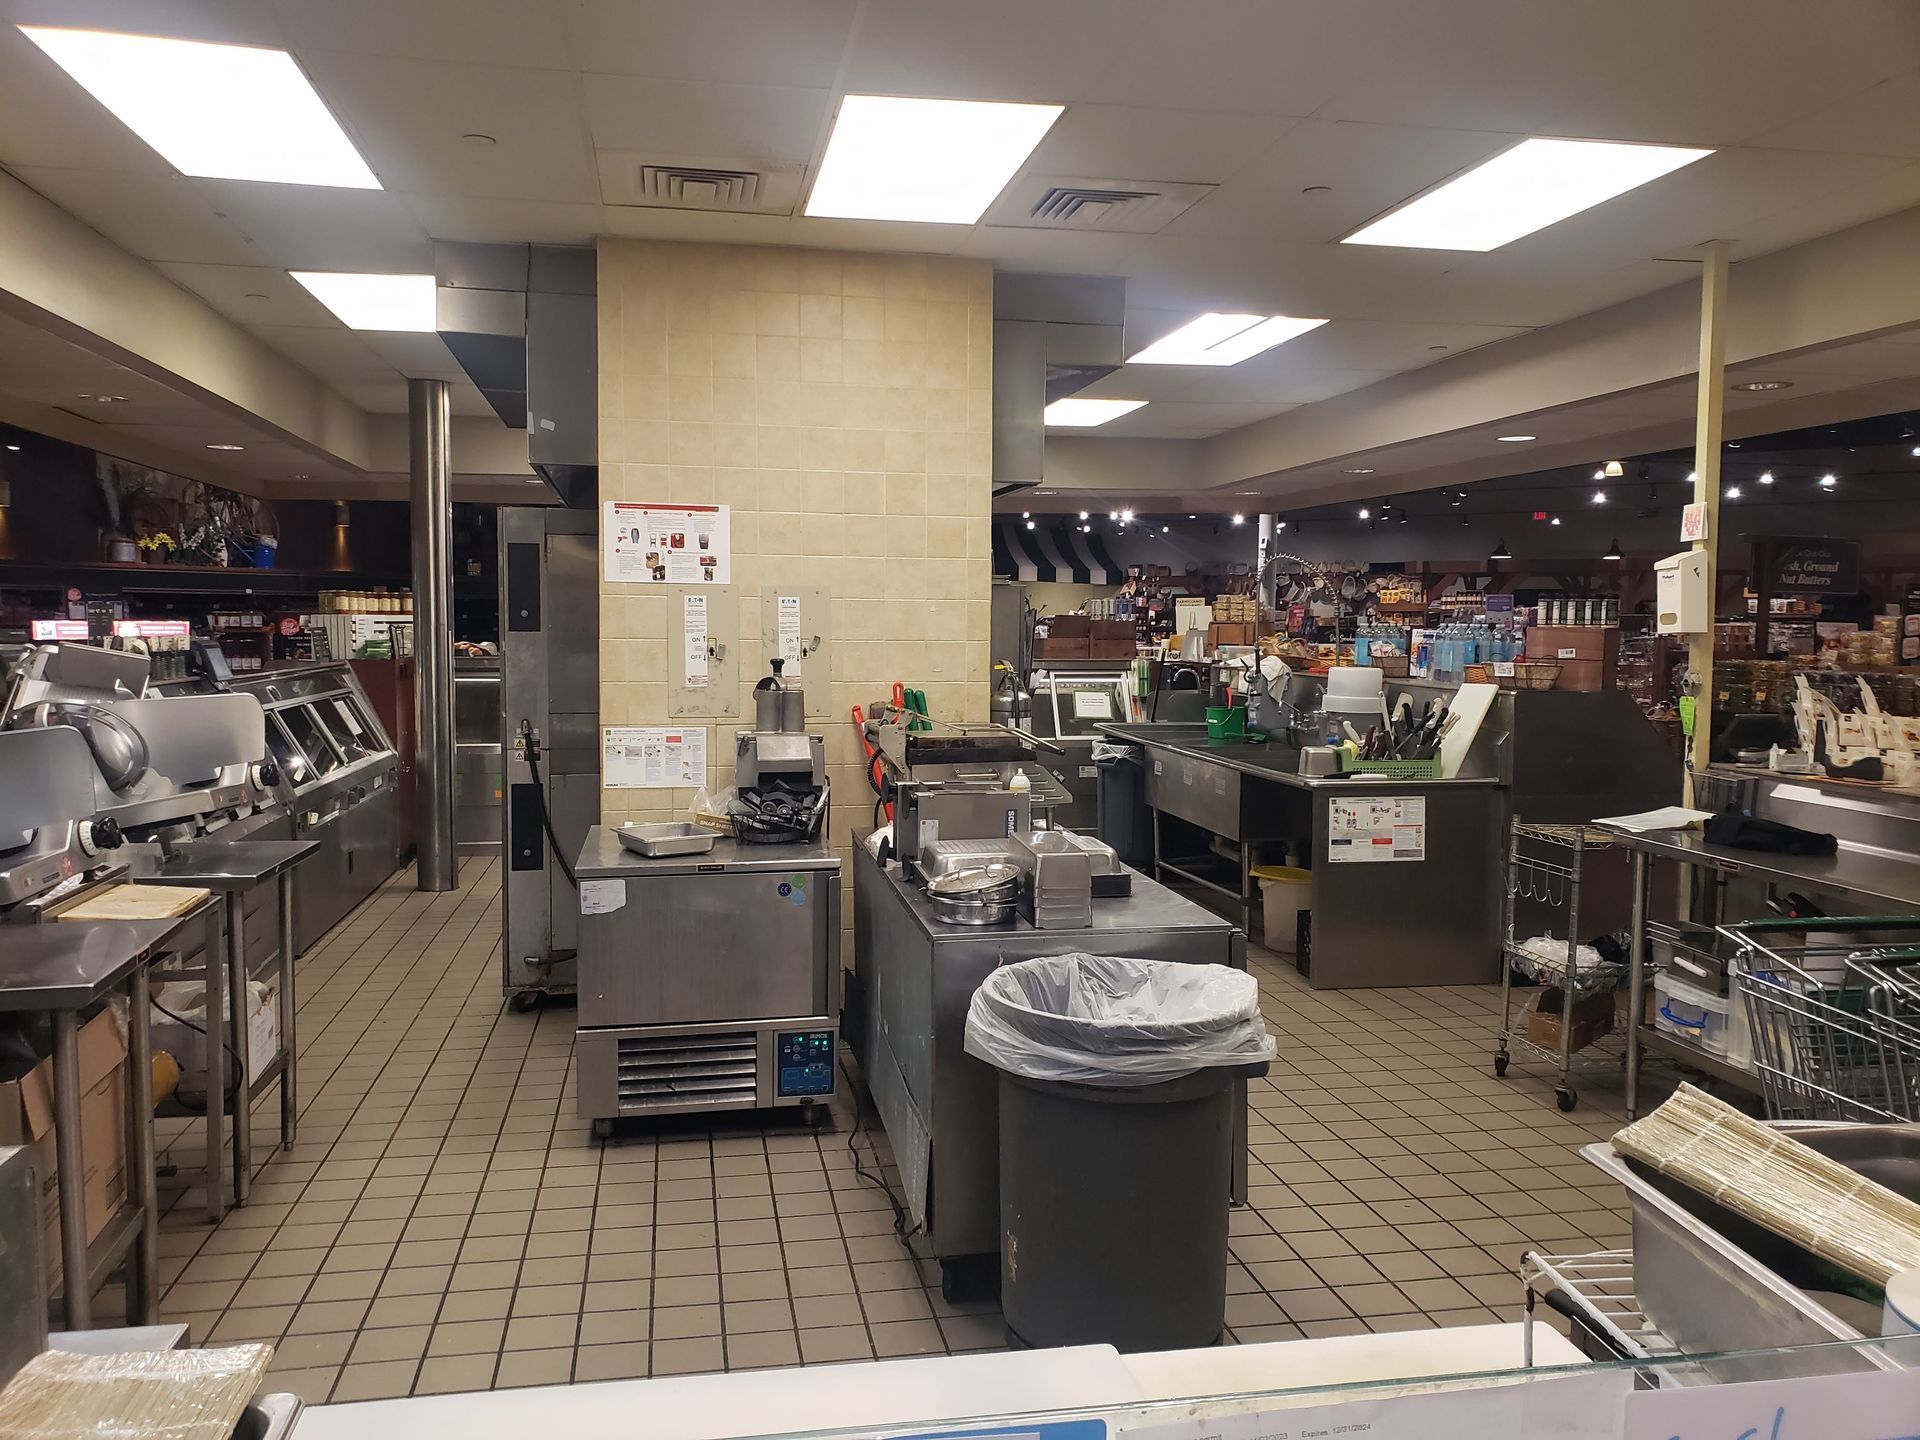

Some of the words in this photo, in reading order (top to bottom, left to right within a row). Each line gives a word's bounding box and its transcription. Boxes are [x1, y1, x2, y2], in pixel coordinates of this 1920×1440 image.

[1803, 561, 1839, 572] Ground
[1779, 573, 1797, 584] Nut
[1797, 574, 1832, 585] Butters
[1333, 1423, 1371, 1434] 12/31/2024
